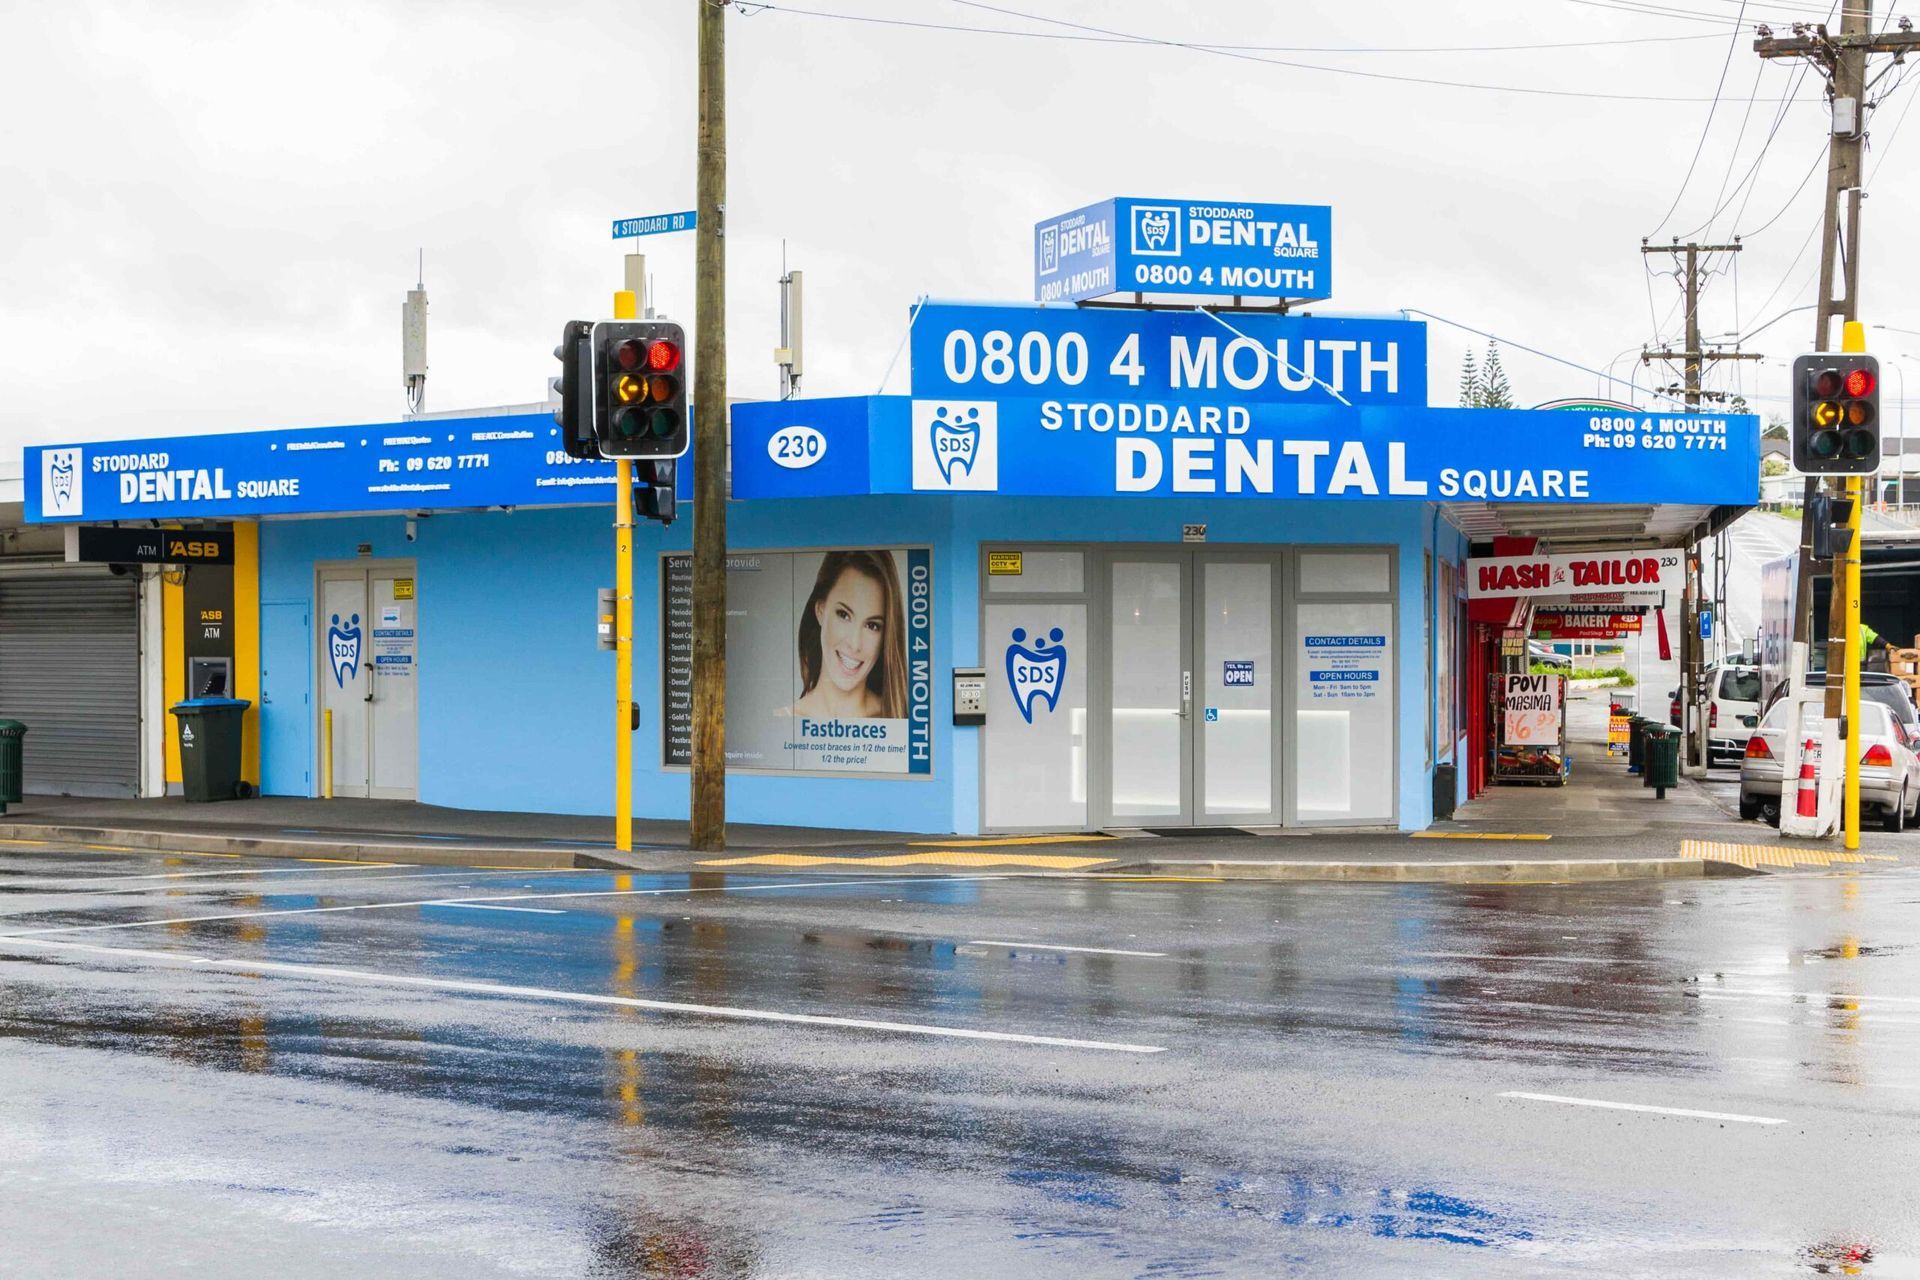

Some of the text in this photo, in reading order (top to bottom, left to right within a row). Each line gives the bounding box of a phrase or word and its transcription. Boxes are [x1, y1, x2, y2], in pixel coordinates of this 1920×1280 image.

[1189, 206, 1254, 220] STODDARD
[622, 215, 685, 235] STODDARD RD
[1147, 225, 1165, 236] SDS
[1060, 219, 1110, 258] DENTAL
[1189, 220, 1318, 248] DENTAL
[1273, 246, 1319, 258] SQUARE
[1040, 265, 1109, 302] 0800 4 MOUTH
[1135, 264, 1314, 290] 0800 4 MOUTH
[943, 330, 1399, 394] 0800 4 MOUTH
[1040, 400, 1251, 436] STODDARD
[1589, 417, 1727, 434] 0800 4 MOUTH
[777, 434, 819, 458] 230
[939, 438, 971, 452] SDS
[1584, 434, 1727, 450] Ph: 09 620 7771
[92, 452, 170, 473] STODDARD
[378, 454, 490, 472] Ph: 09 620 7771
[1115, 437, 1428, 496] DENTAL
[54, 475, 69, 488] SDS
[120, 468, 232, 504] DENTAL
[236, 479, 300, 498] SQUARE
[1438, 468, 1590, 498] SQUARE
[1184, 525, 1206, 536] 230
[136, 544, 157, 556] ATM
[991, 560, 1008, 568] CCTV
[1660, 557, 1678, 568] 230
[1478, 563, 1550, 591] HASH
[1568, 558, 1660, 587] TAILOR
[672, 597, 690, 606] Scaling
[1852, 600, 1858, 608] 3
[1565, 614, 1611, 628] BAKERY
[204, 627, 220, 639] ATM
[334, 644, 355, 658] SDS
[911, 565, 929, 760] 0800 4 MOUTH
[1018, 666, 1055, 684] SDS
[1226, 670, 1252, 682] OPEN
[1320, 672, 1373, 680] OPEN HOURS
[1508, 674, 1548, 694] POVI
[1505, 694, 1552, 712] MASIMA
[802, 719, 887, 739] Fastbraces
[672, 749, 685, 757] And
[784, 742, 810, 750] Lowest
[828, 743, 851, 752] braces
[853, 744, 860, 752] in
[862, 744, 872, 752] 1/2
[874, 744, 886, 752] the
[888, 744, 906, 753] time!
[822, 755, 868, 765] 1/2 the price!
